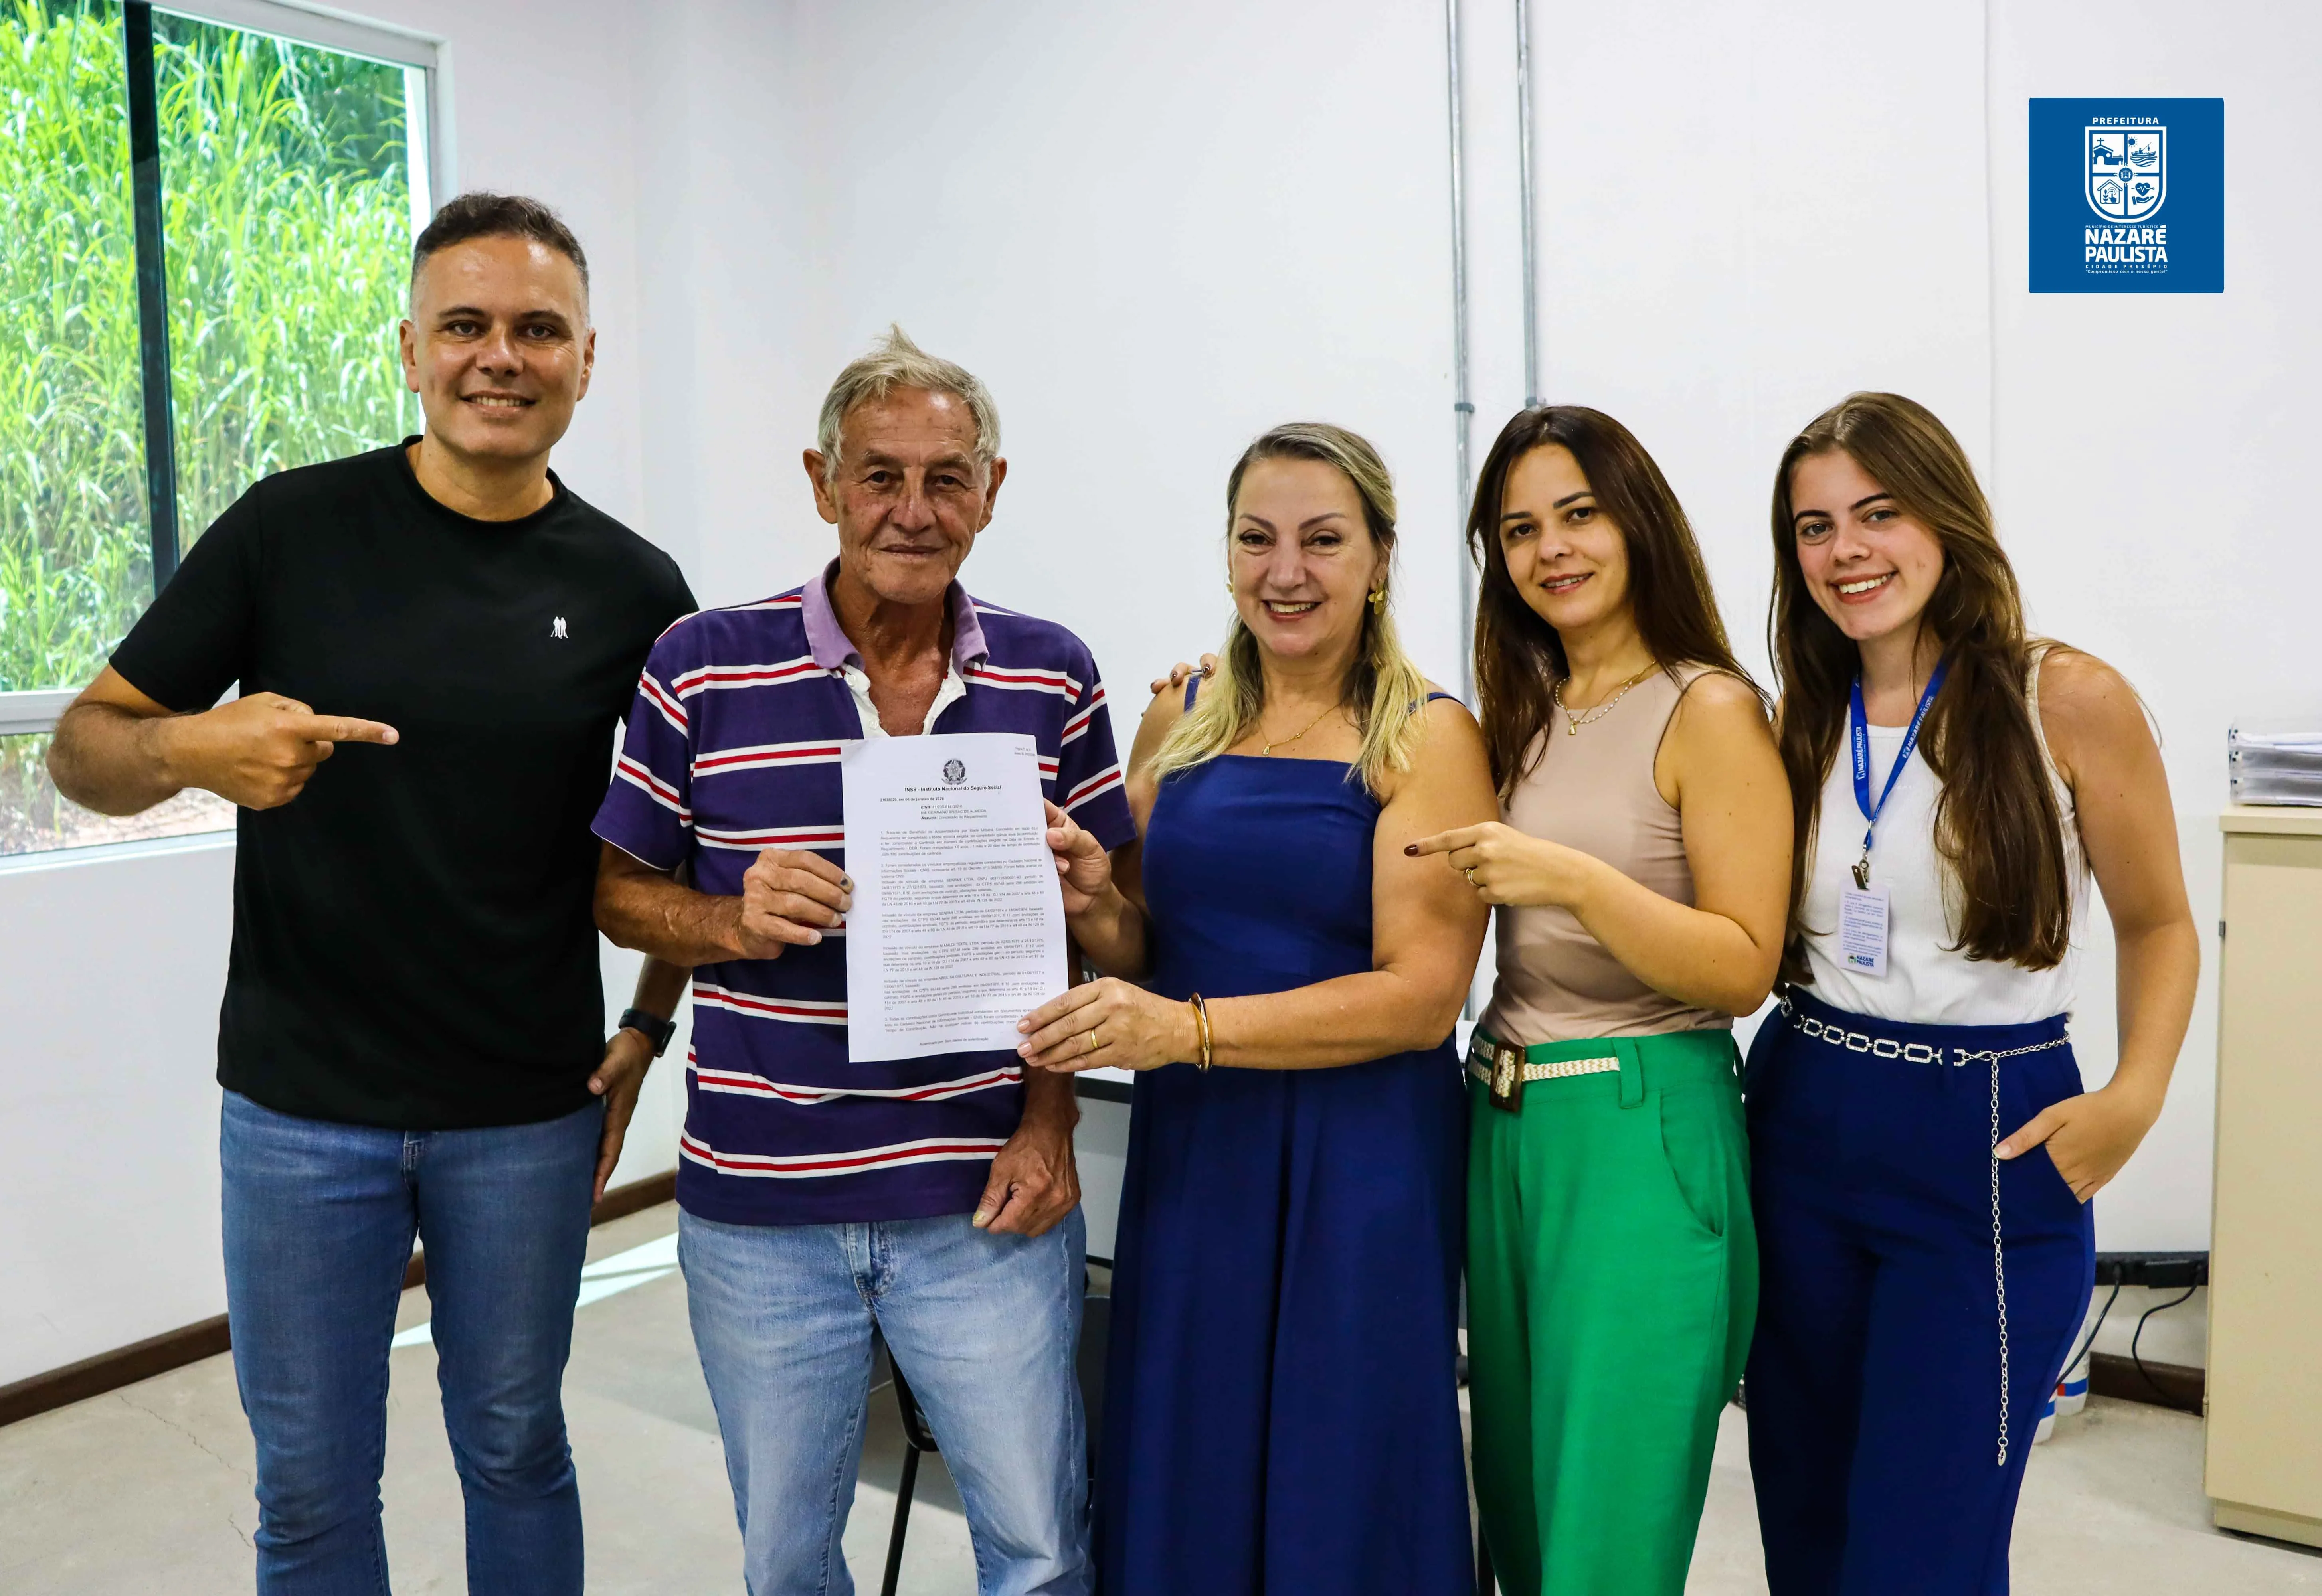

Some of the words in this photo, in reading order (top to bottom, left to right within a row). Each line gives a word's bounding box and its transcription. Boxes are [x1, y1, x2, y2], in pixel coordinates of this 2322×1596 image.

[1908, 720, 1921, 747] NAZARÉ
[1919, 695, 1934, 721] PAULISTA
[1856, 749, 1864, 772] NAZARÉ
